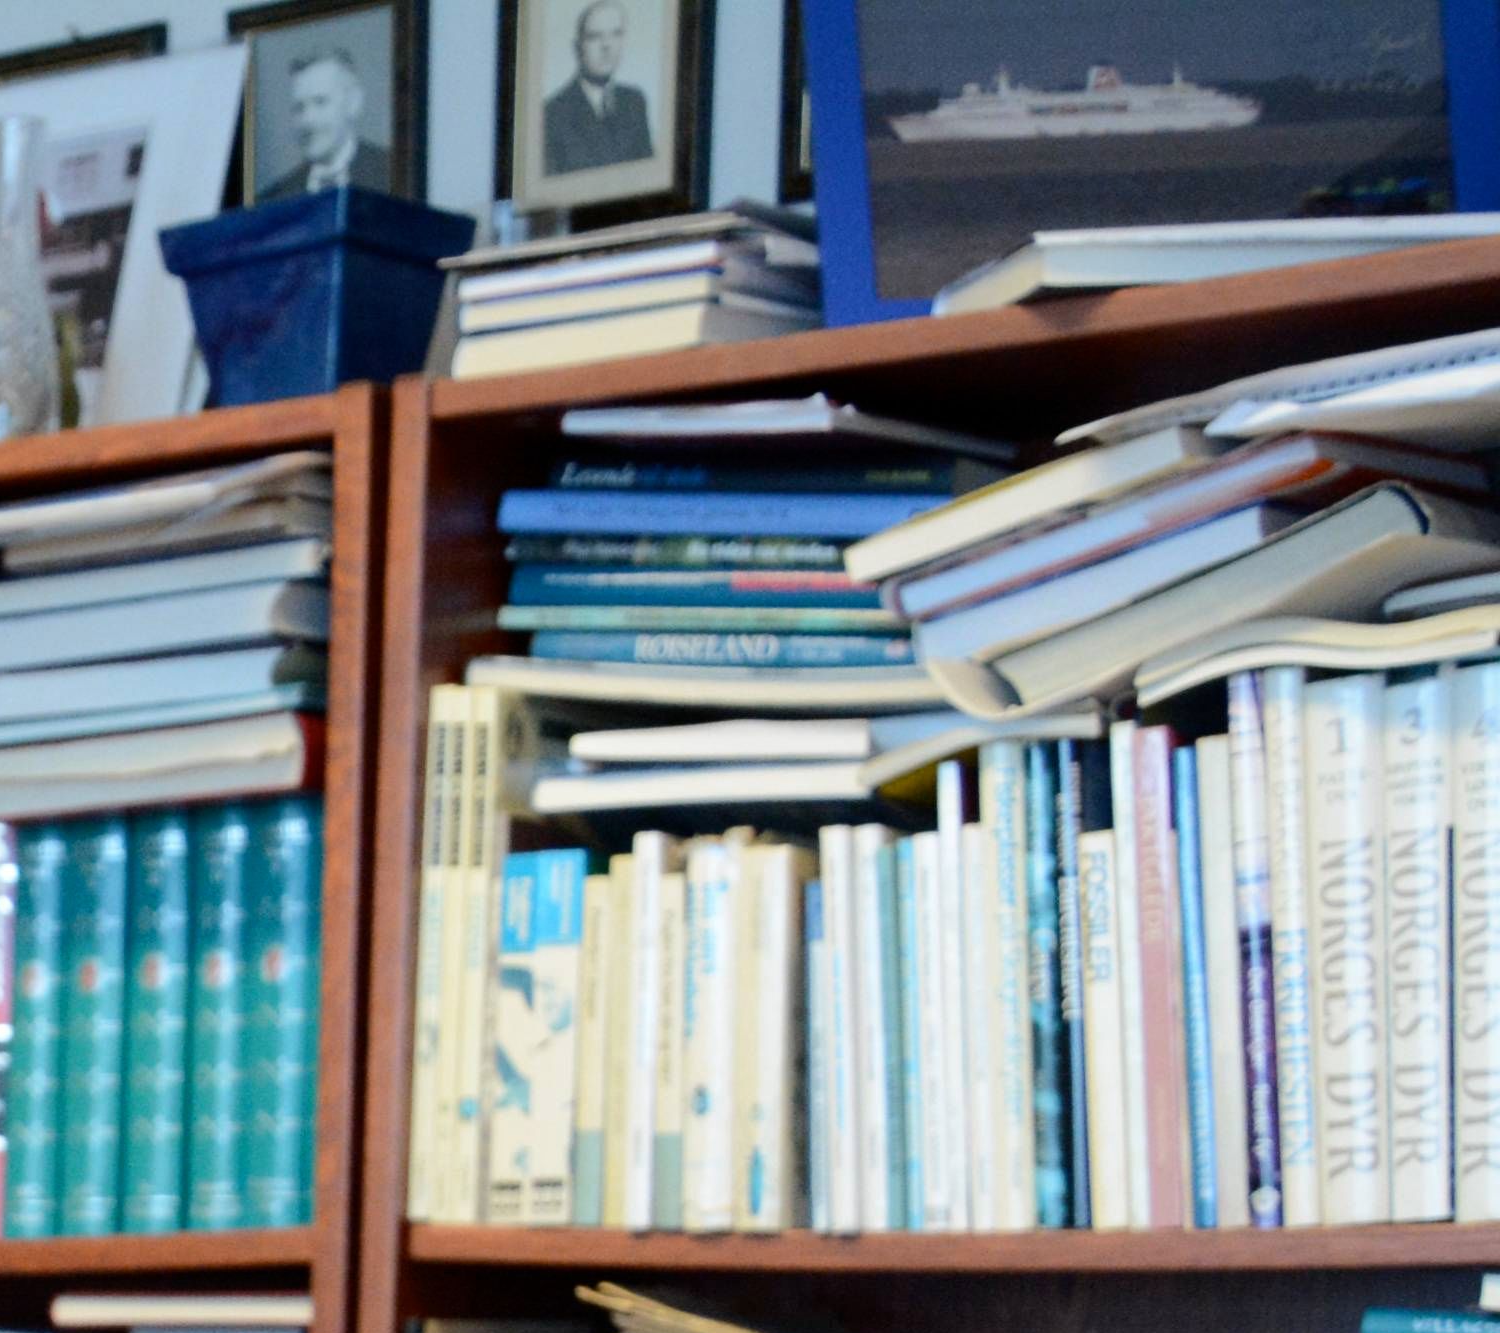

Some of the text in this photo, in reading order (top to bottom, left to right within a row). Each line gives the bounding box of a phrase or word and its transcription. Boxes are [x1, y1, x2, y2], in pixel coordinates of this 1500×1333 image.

[1081, 850, 1113, 984] FOSSILER
[1319, 835, 1378, 1180] NORGES DYR
[1388, 828, 1442, 1169] NORGES DYR
